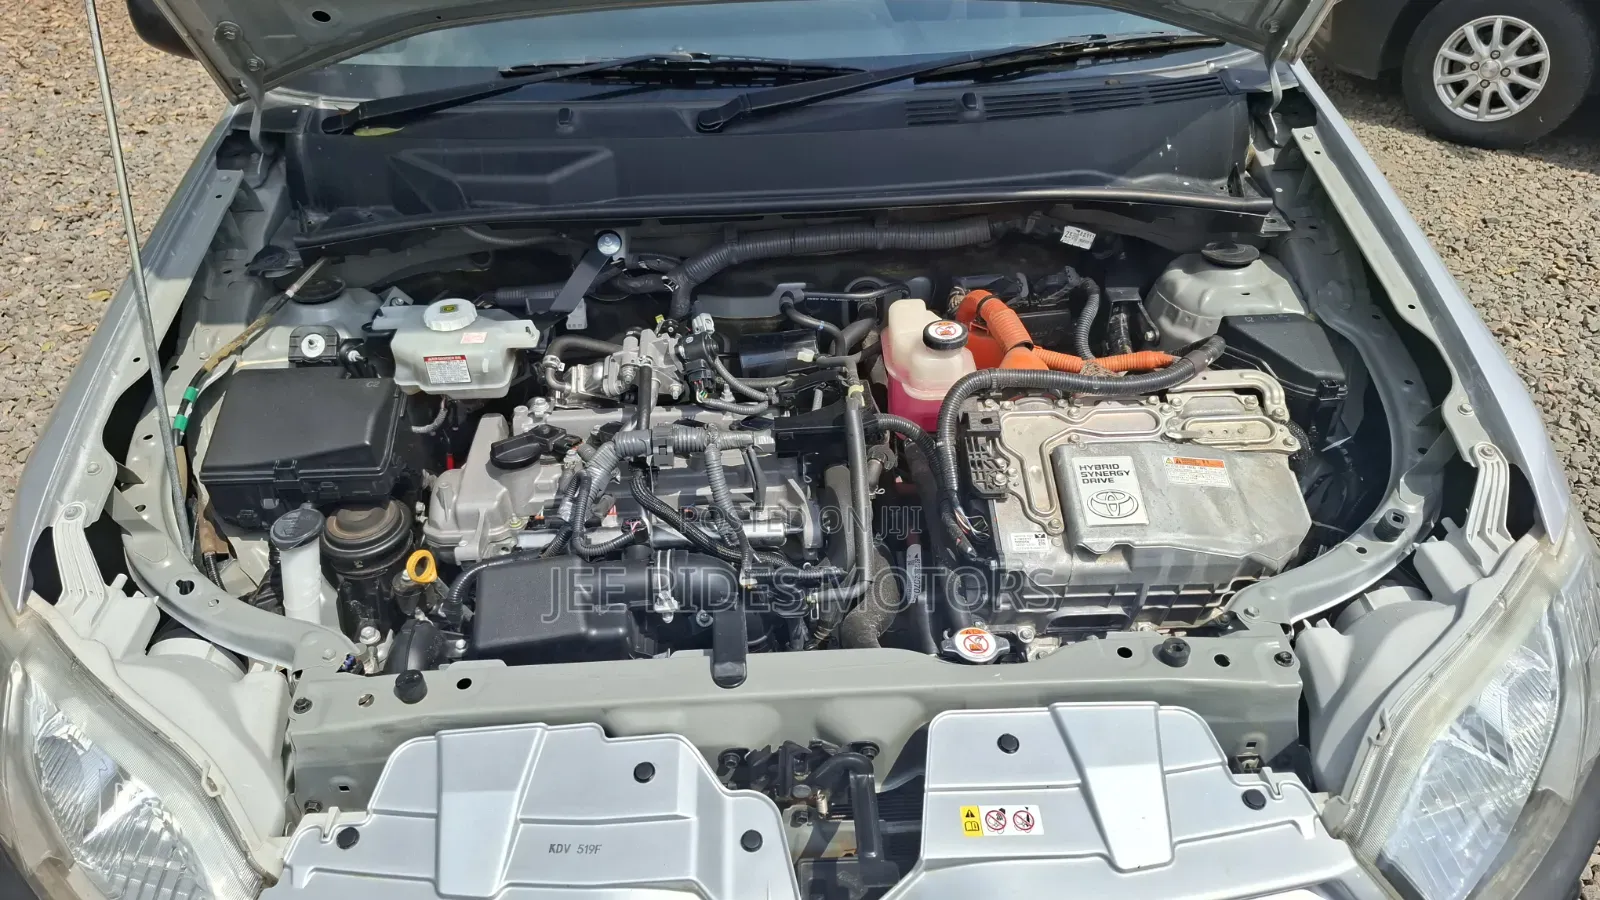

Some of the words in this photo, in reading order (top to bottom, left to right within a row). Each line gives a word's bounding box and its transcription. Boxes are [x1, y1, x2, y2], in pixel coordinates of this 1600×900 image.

[1079, 463, 1120, 471] HYBRID
[1080, 470, 1131, 478] SYNERGY
[1082, 477, 1115, 485] DRIVE
[548, 843, 572, 854] KDV
[576, 843, 602, 855] 519F
